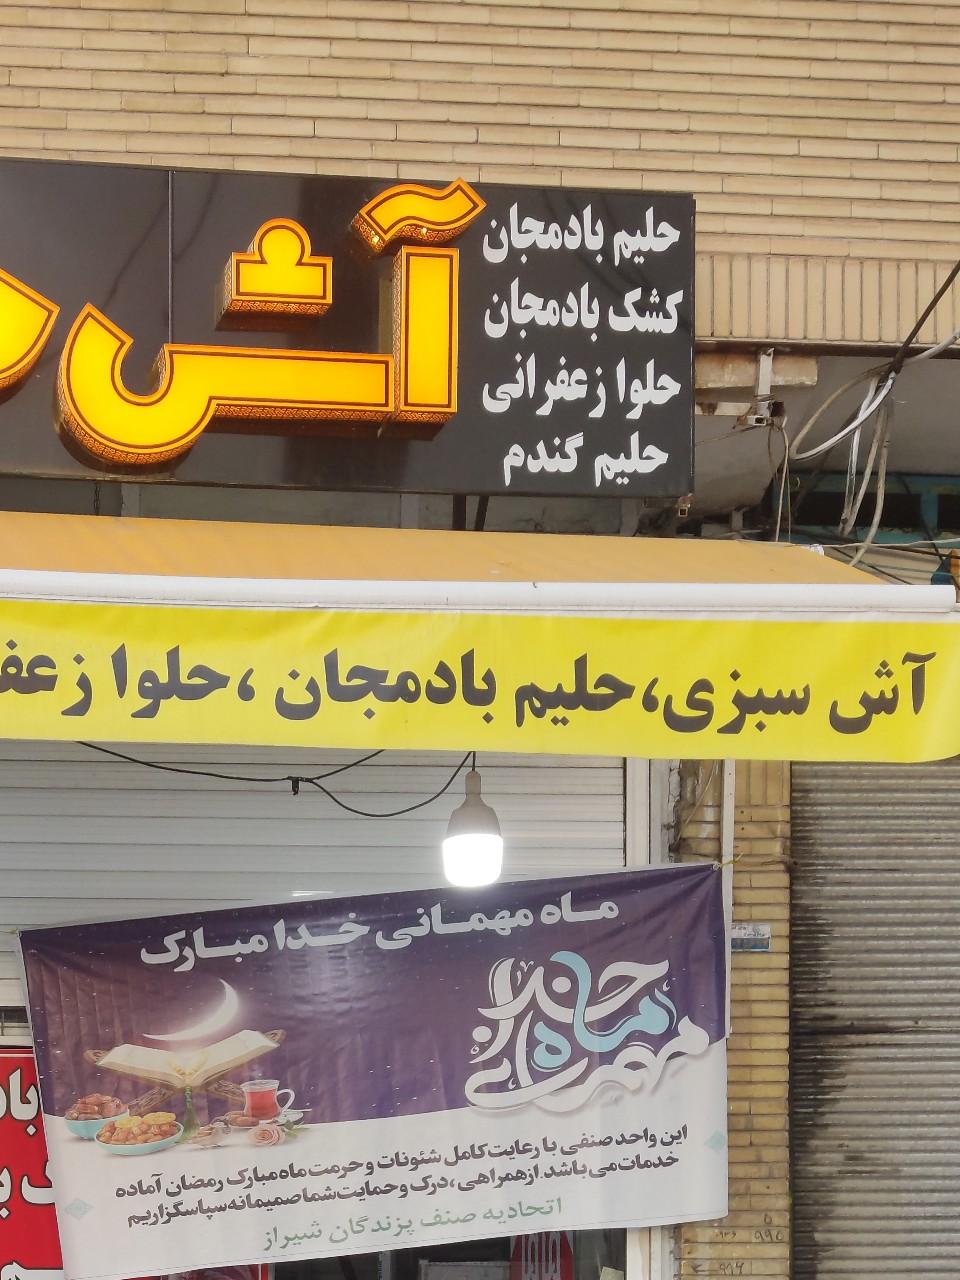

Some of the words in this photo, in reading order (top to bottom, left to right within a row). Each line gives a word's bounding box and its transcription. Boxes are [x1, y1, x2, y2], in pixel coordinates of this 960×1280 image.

[482, 202, 606, 266] بادمجان
[613, 206, 682, 267] حلیم
[56, 178, 487, 466] آش
[483, 280, 601, 342] بادمجان
[608, 288, 684, 335] کشک
[482, 353, 607, 418] زعفرانی
[616, 357, 682, 419] حلوا
[502, 432, 584, 486] گندم
[594, 432, 670, 488] حلیم
[275, 647, 498, 724] بادمجان
[827, 651, 937, 735] آش
[539, 890, 620, 925] ماه
[273, 914, 371, 955] خدا
[374, 901, 535, 952] مهمانی
[139, 927, 271, 973] مبارک
[487, 1139, 540, 1161] رعایت
[541, 1136, 558, 1157] با
[560, 1133, 614, 1156] صنفی
[615, 1127, 658, 1149] واحد
[660, 1124, 689, 1147] این
[444, 1143, 489, 1167] کامل
[617, 1150, 680, 1172] خدمات
[115, 1172, 163, 1199] آماده
[165, 1174, 225, 1198] رمضان
[225, 1168, 279, 1190] مبارک
[337, 1180, 399, 1202] حمایت
[457, 1168, 528, 1192] همراهی
[126, 1197, 228, 1228] سپاسگزاریم
[227, 1189, 303, 1213] صمیمانه
[482, 1196, 563, 1222] اتحادیه
[328, 1214, 413, 1244] پزندگان
[419, 1206, 477, 1228] صنف
[263, 1219, 323, 1251] شیراز
